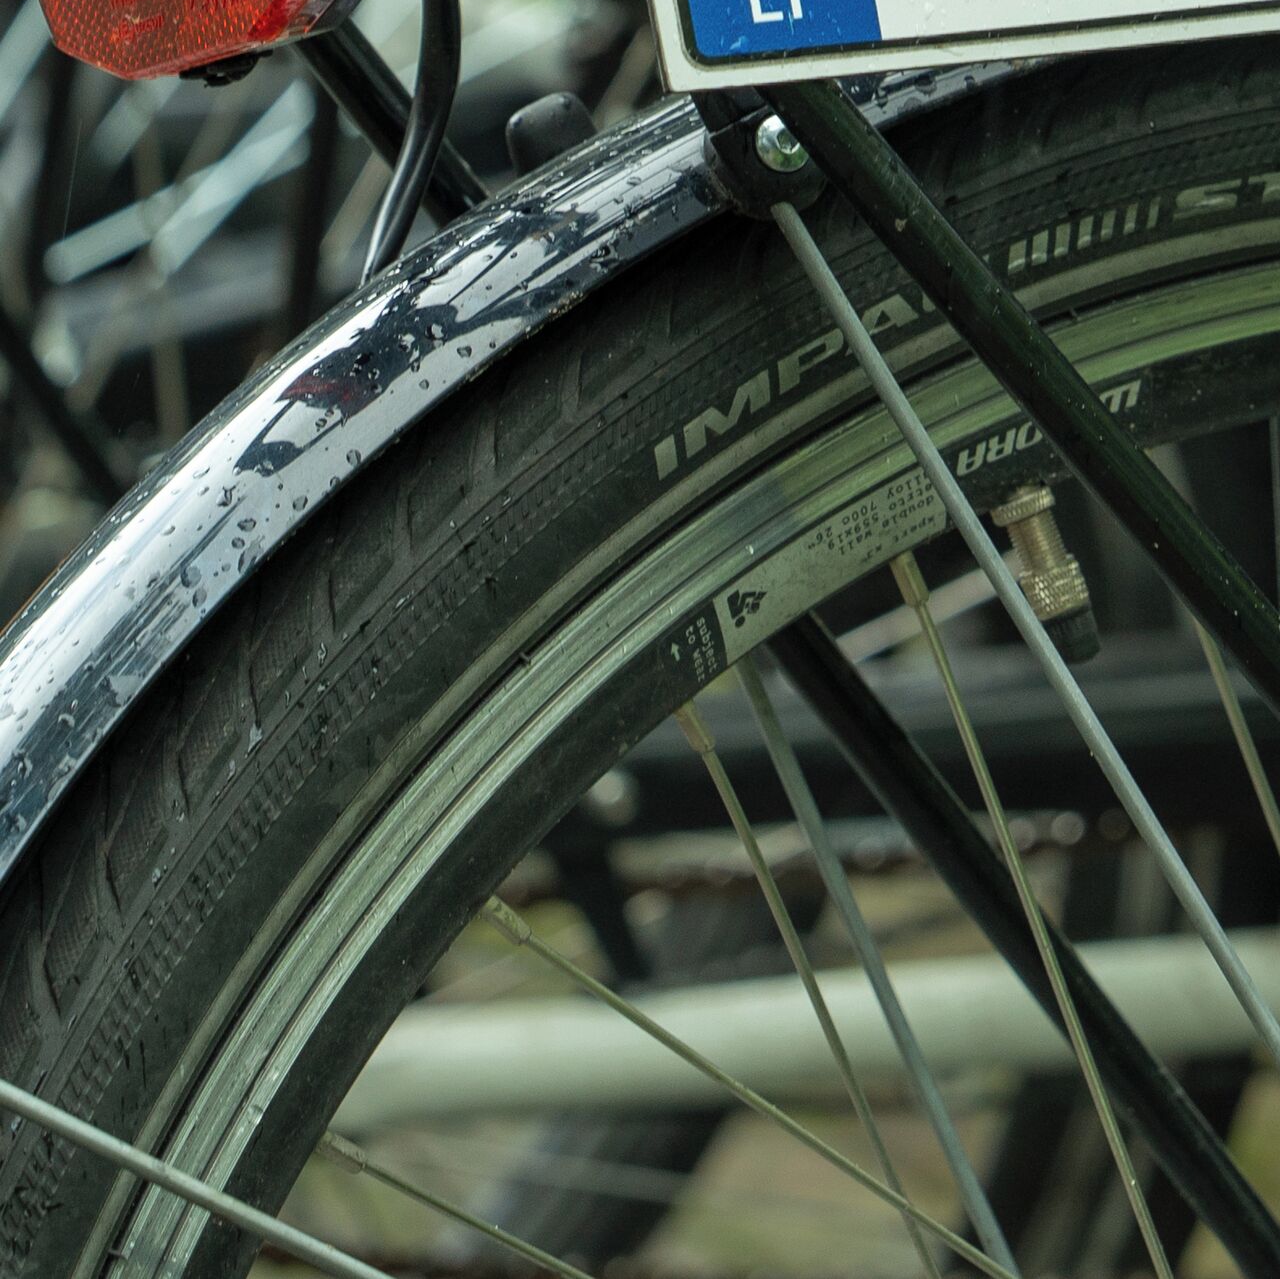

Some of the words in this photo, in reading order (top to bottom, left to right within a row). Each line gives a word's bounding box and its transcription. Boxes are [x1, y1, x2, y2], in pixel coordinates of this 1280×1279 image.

[654, 290, 937, 481] IMPA
[887, 471, 928, 500] lloy
[685, 624, 696, 645] to
[693, 647, 705, 683] wear
[696, 616, 718, 674] subject
